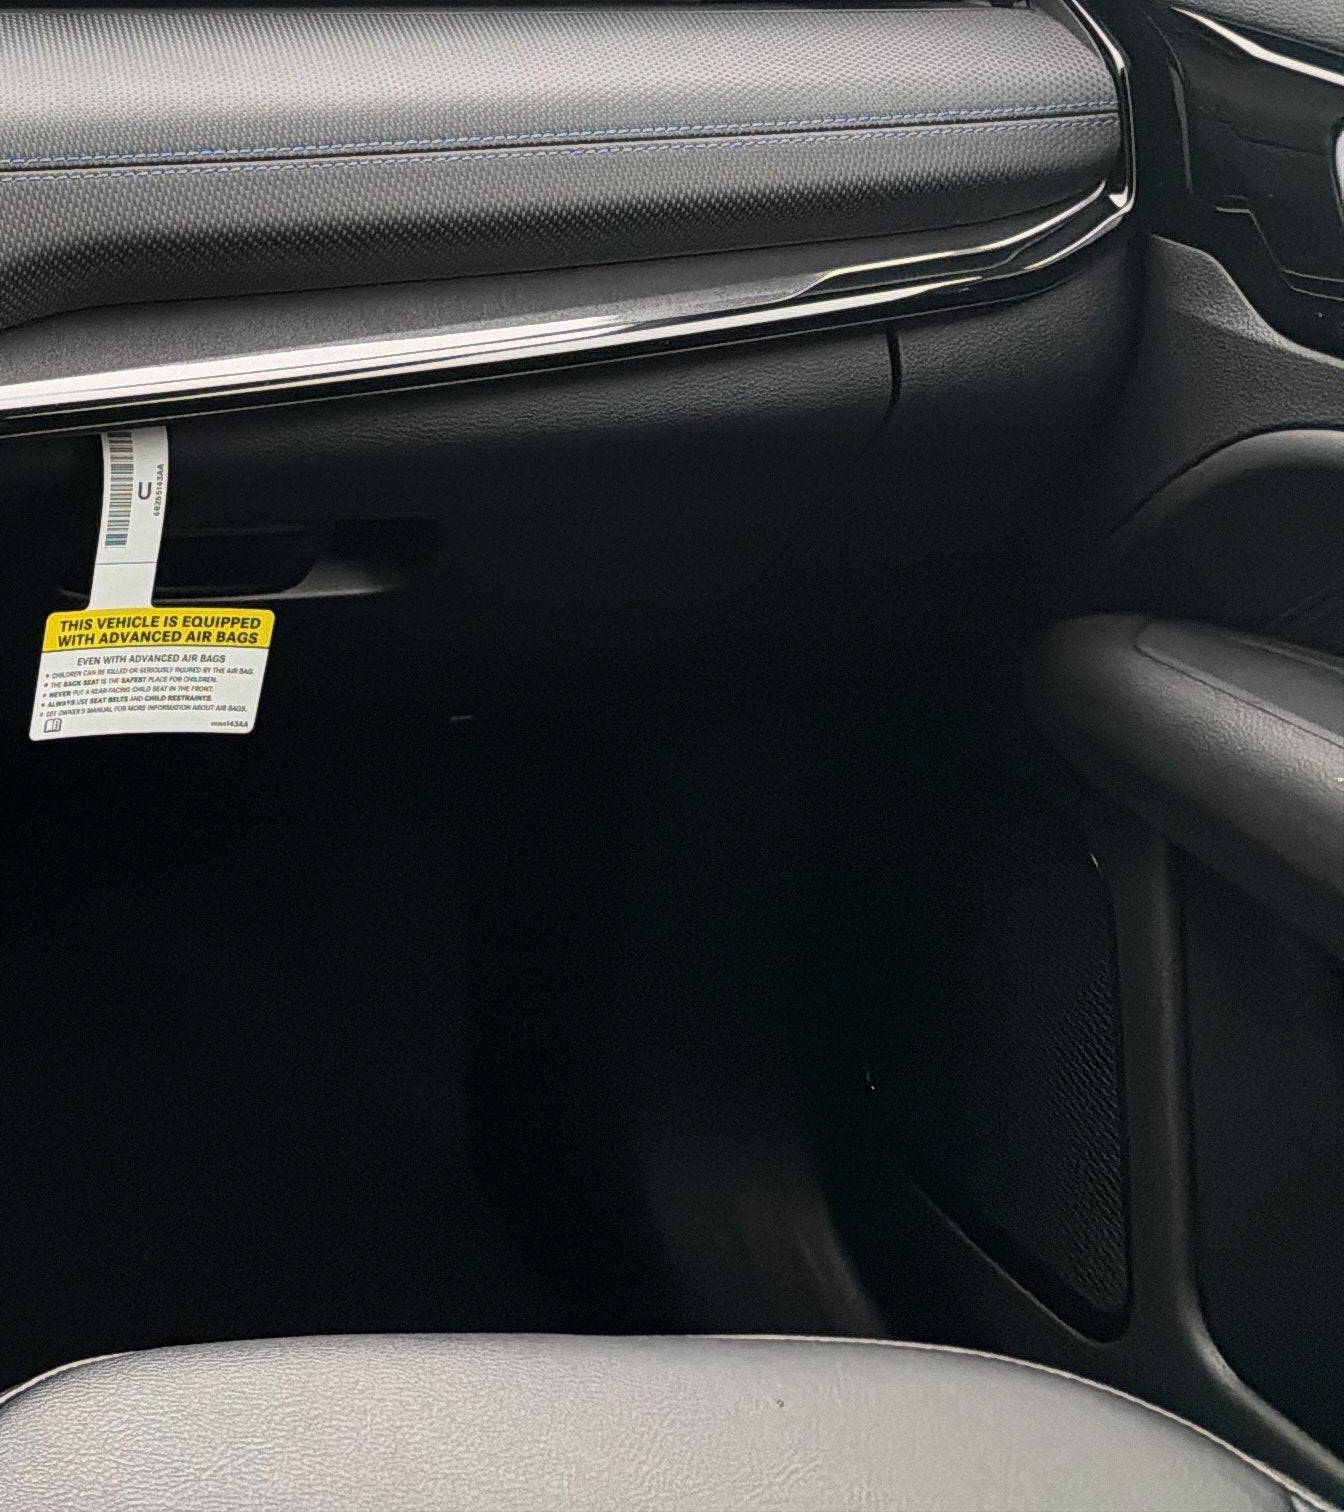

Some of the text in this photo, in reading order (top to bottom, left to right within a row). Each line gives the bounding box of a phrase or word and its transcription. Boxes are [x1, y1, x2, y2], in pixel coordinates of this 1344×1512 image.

[138, 482, 152, 500] U
[60, 615, 261, 632] THIS VEHICLE IS EQUIPPED
[58, 630, 258, 648] WITH ADVANCED AIR BAGS
[77, 654, 226, 666] EVEN WITH ADVANCED AIR BAGS
